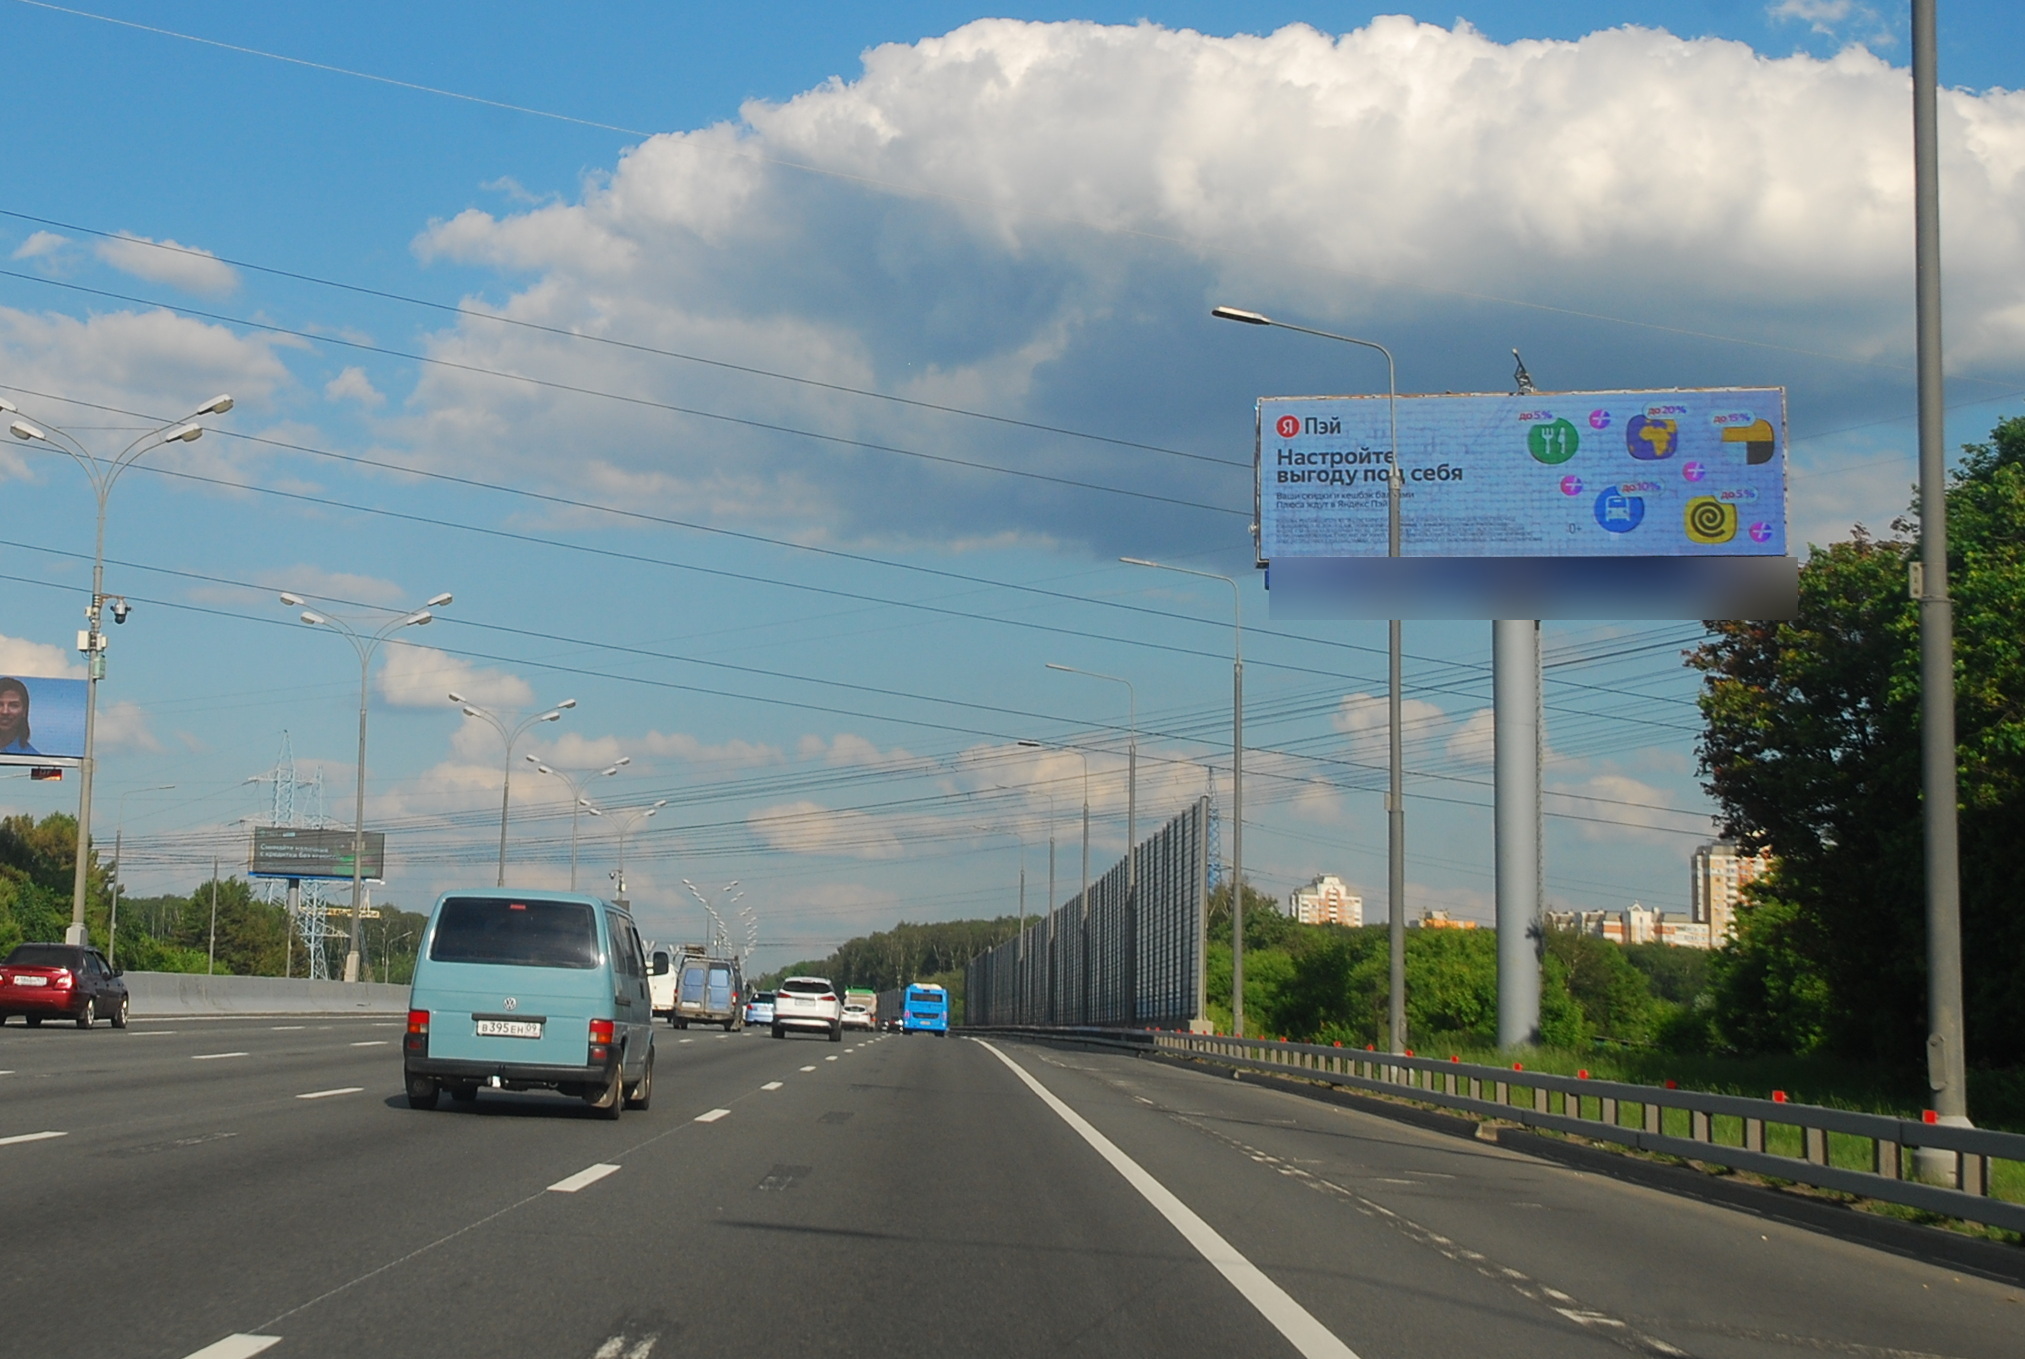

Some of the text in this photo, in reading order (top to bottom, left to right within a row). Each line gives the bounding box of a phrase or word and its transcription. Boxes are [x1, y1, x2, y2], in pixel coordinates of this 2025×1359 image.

[1662, 406, 1687, 415] 20%
[1534, 411, 1553, 420] 5%
[1728, 413, 1752, 422] 15%
[1304, 416, 1342, 435] Пэй
[1277, 447, 1394, 468] Настройте
[1277, 468, 1358, 486] выгоду
[1410, 463, 1463, 482] себя
[1276, 491, 1301, 500] Ваши
[1736, 489, 1756, 498] 5%
[1337, 500, 1370, 509] Яндекс
[1371, 499, 1388, 508] Пэй
